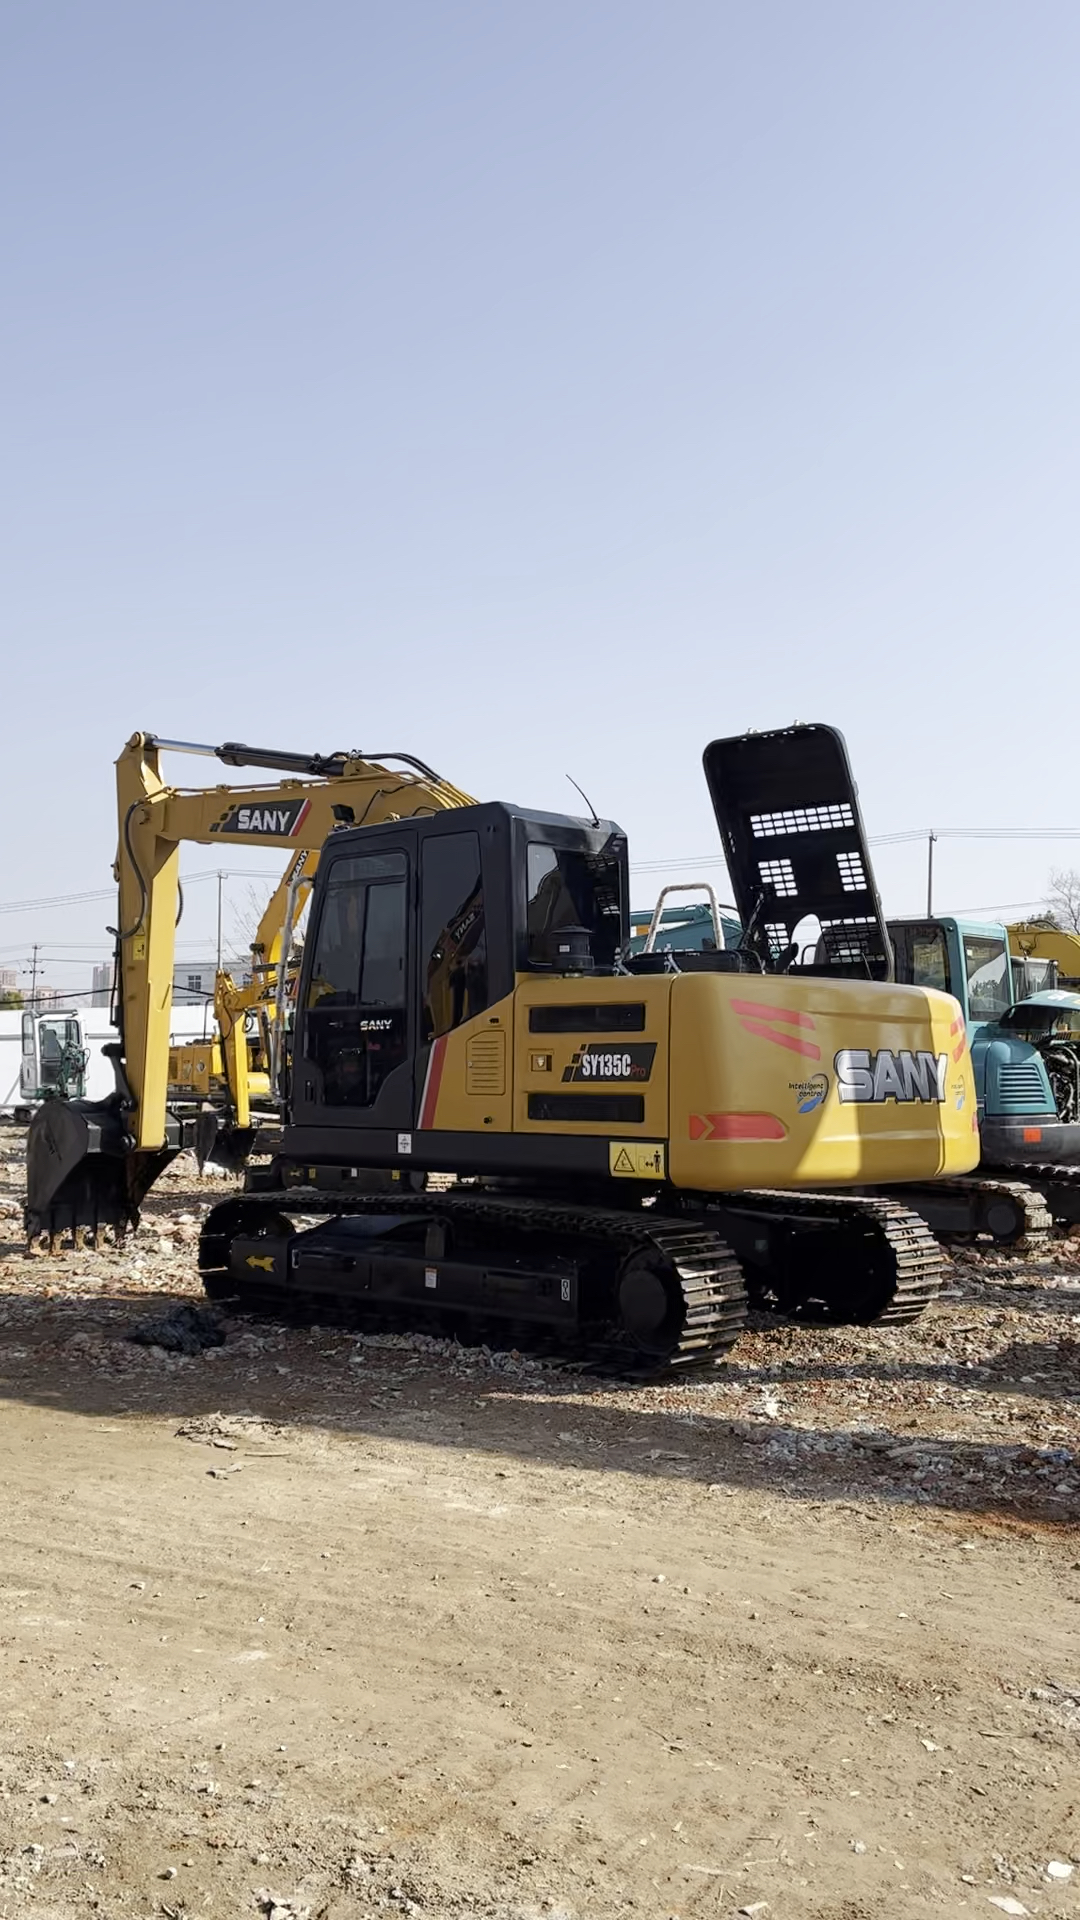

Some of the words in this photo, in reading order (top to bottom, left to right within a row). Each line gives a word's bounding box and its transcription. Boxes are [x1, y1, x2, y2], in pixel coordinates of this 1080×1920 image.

[237, 808, 291, 832] SANY
[360, 1019, 393, 1030] SANY
[582, 1053, 631, 1076] SY135C
[833, 1049, 948, 1104] SANY
